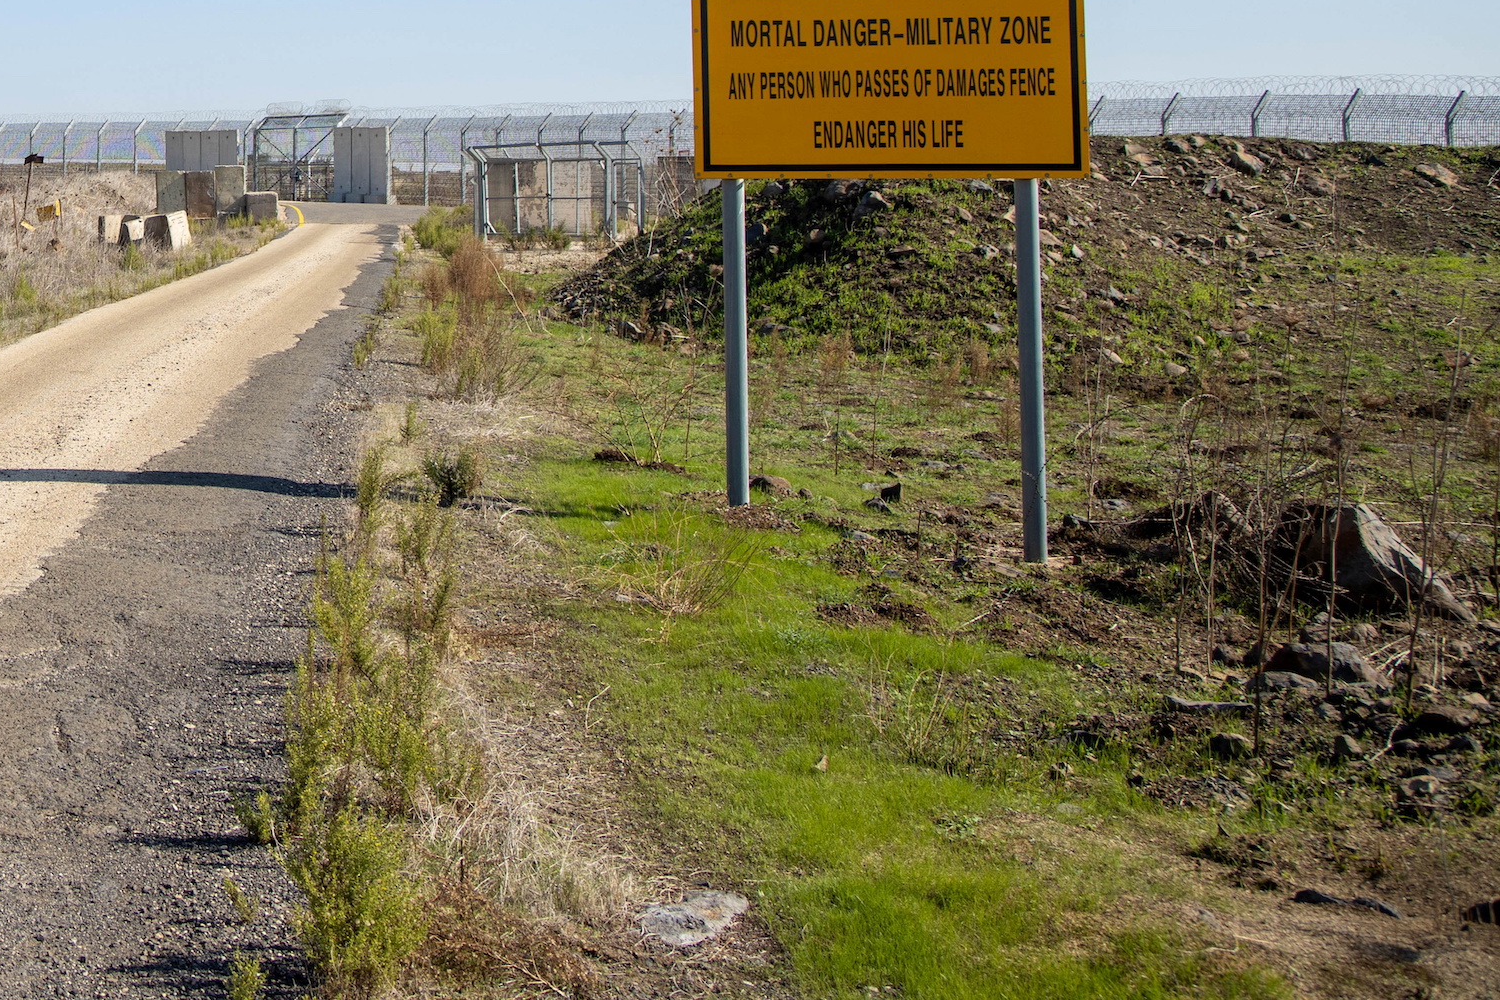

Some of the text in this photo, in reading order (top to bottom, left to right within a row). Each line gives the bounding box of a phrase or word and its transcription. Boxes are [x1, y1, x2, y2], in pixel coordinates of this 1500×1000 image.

[730, 19, 808, 48] MORTAL
[999, 15, 1052, 45] ZONE
[728, 67, 1056, 100] ANY PERSON WHO PASSES OF DAMAGES FENCE
[813, 119, 965, 149] ENDANGER HIS LIFE
